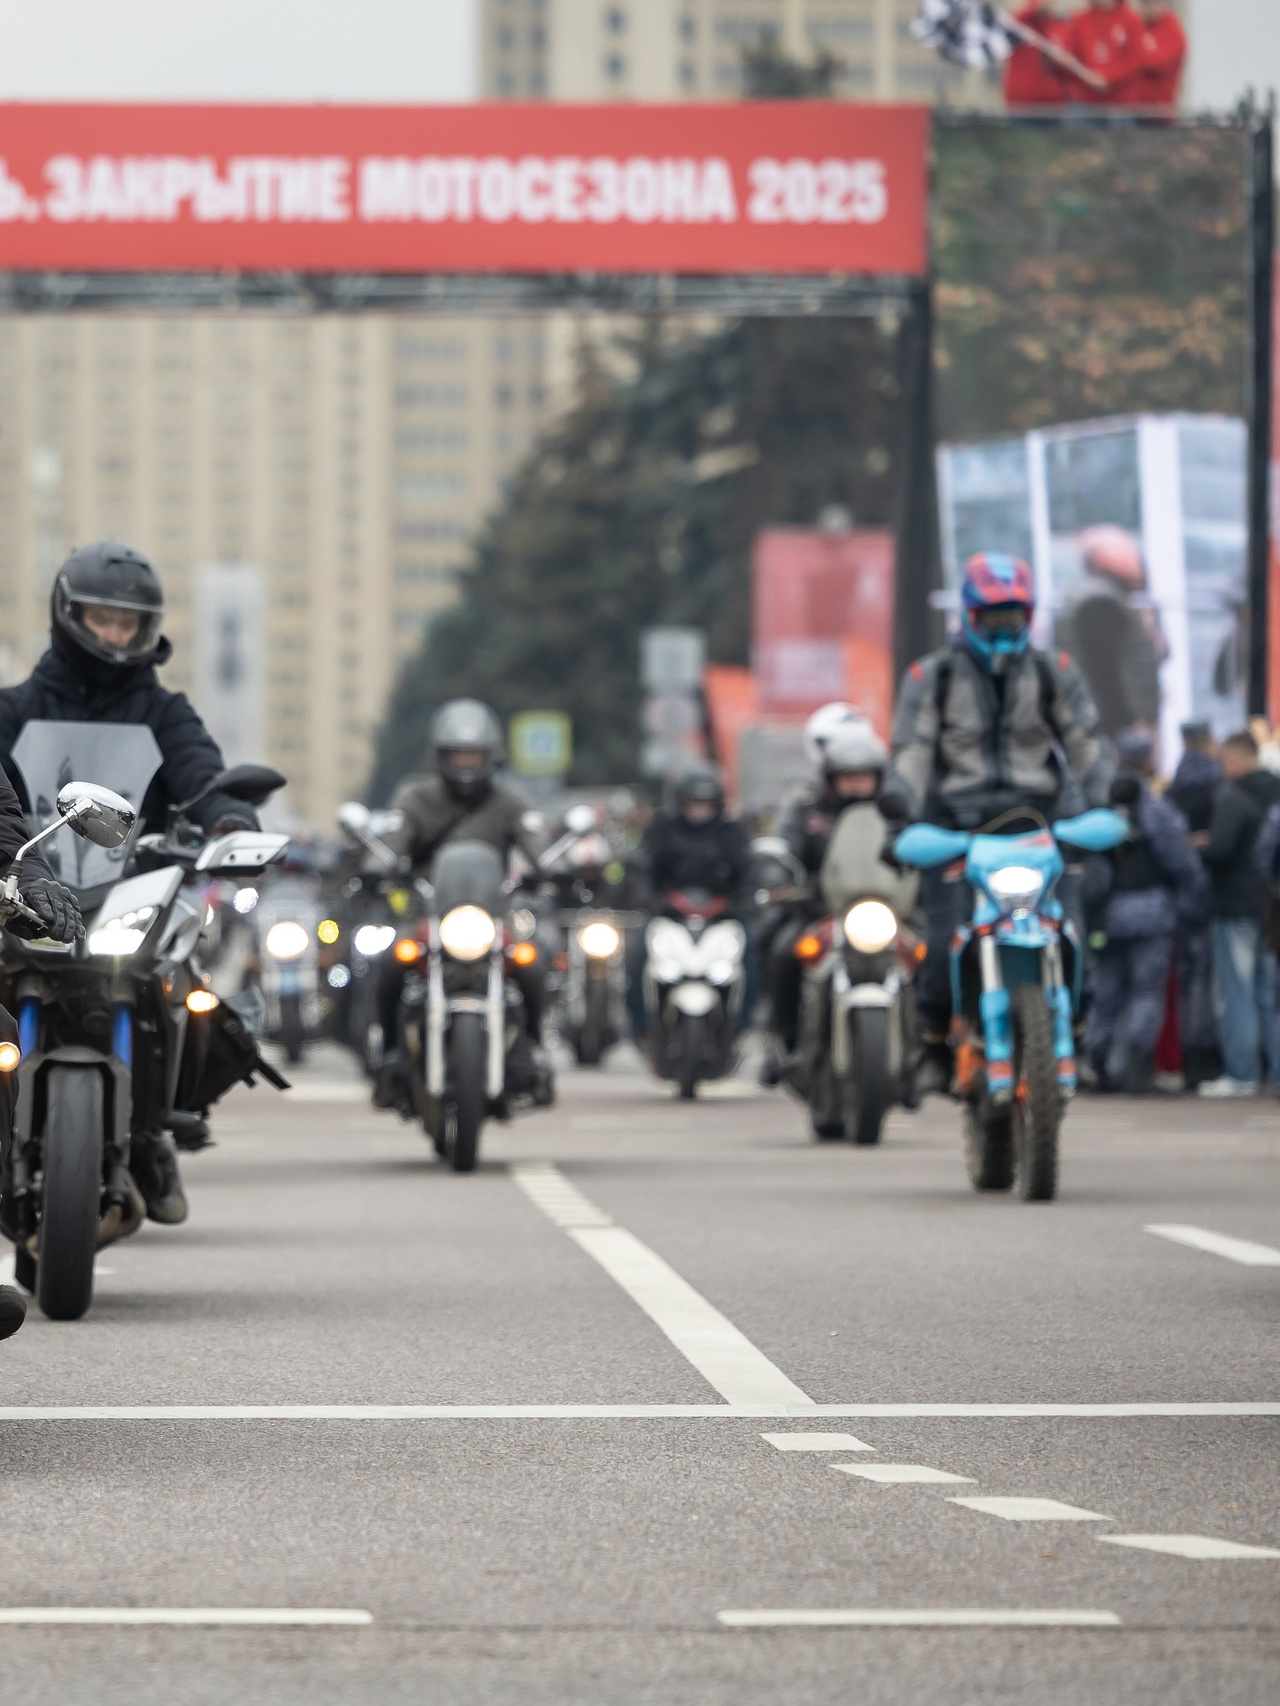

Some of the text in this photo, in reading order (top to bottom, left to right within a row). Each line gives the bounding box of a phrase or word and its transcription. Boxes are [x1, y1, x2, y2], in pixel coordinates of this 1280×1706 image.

[43, 154, 351, 223] ЗАКРЫТИЕ
[358, 155, 738, 223] МОТОСЕЗОНА
[747, 158, 887, 223] 2025
